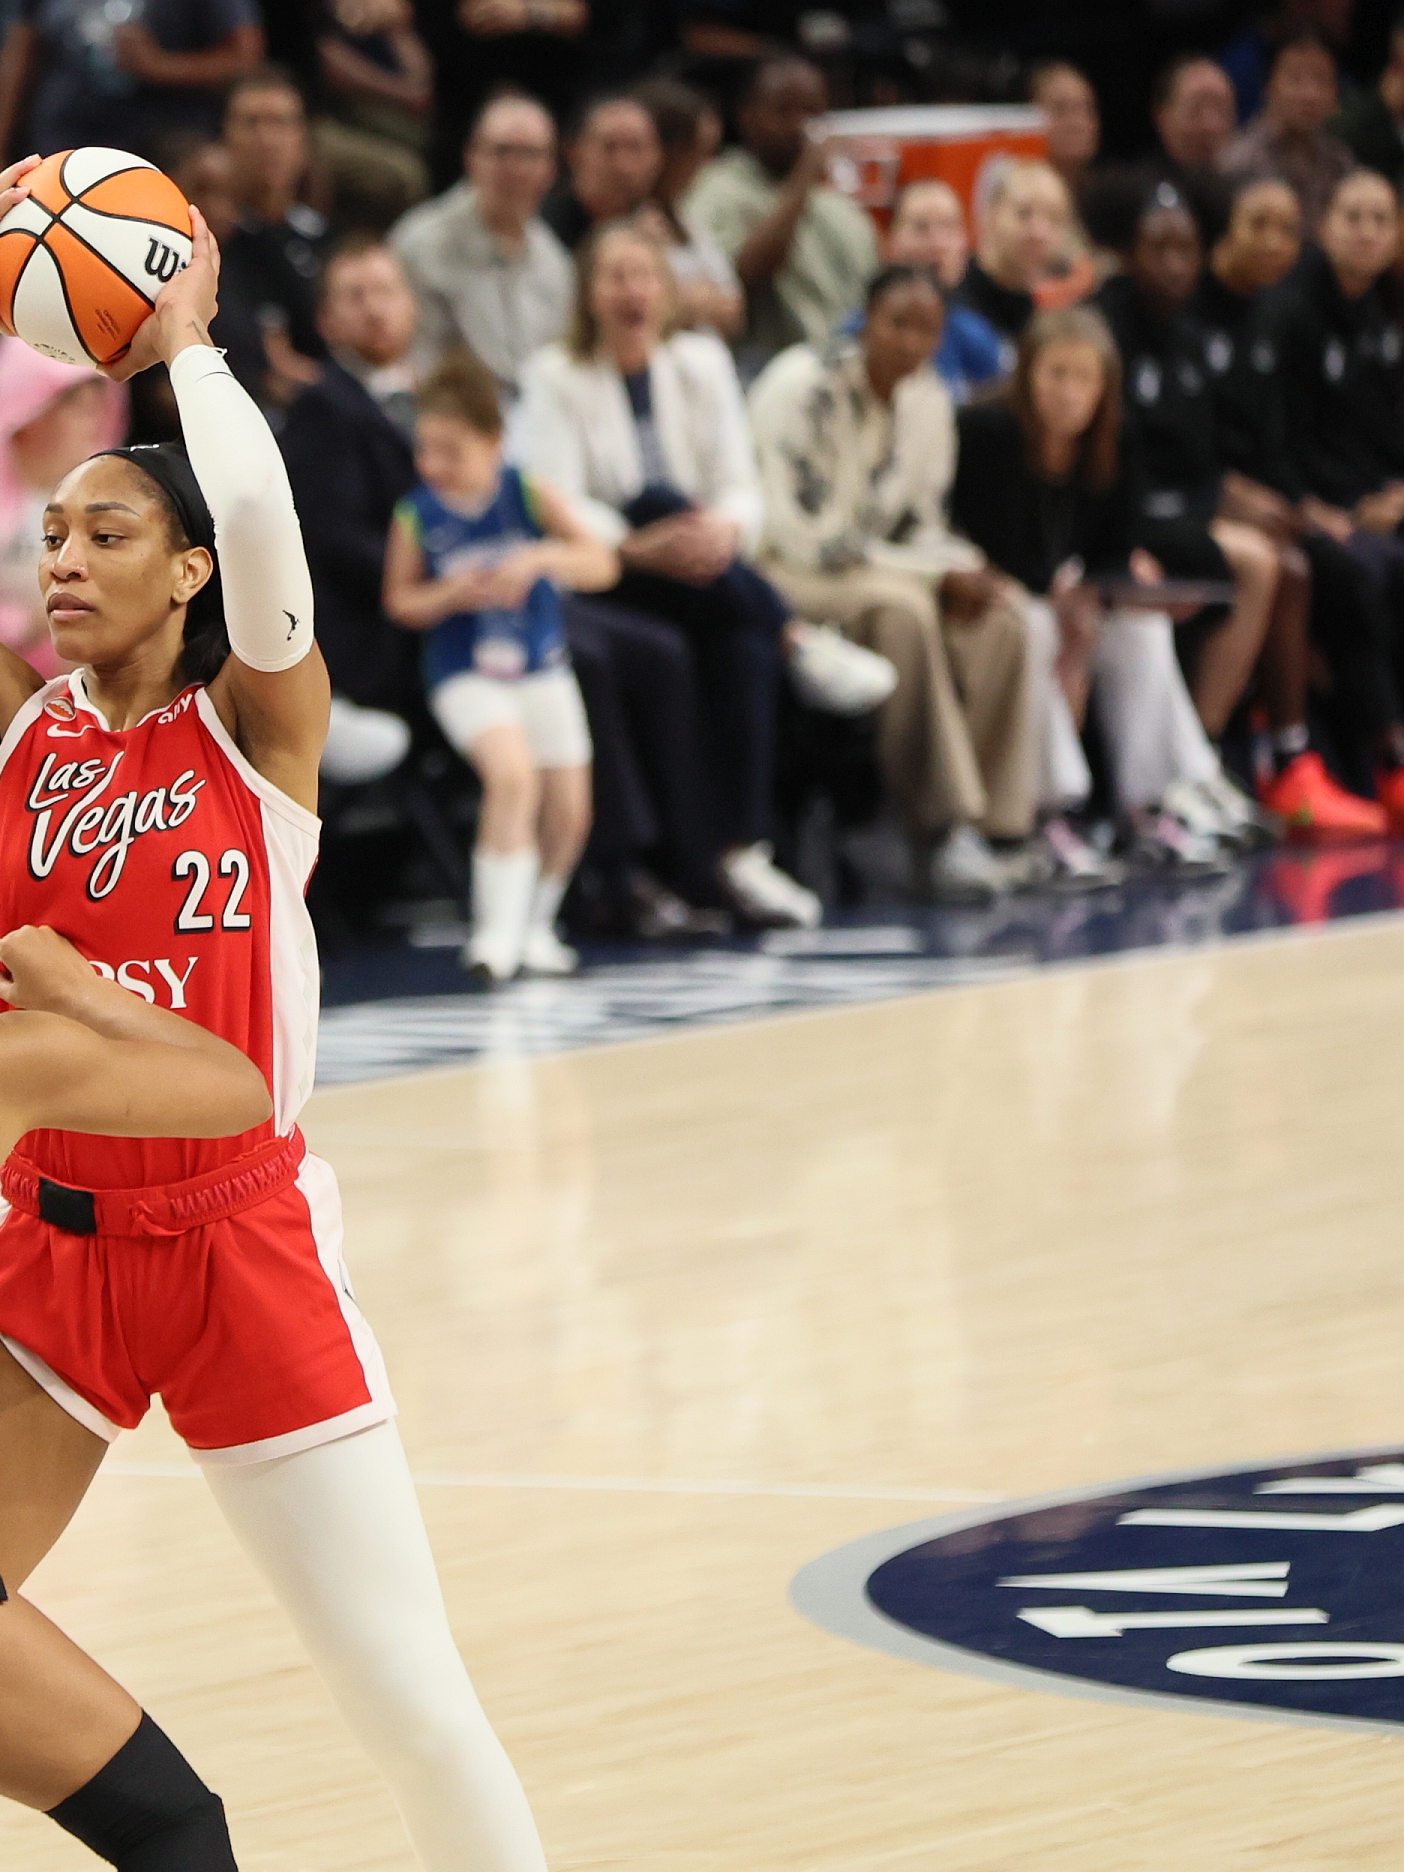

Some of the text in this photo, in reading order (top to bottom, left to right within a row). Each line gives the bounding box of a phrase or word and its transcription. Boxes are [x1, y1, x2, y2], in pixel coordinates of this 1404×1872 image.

[26, 752, 107, 811] Las
[29, 750, 208, 901] Vegas
[173, 847, 252, 935] 22
